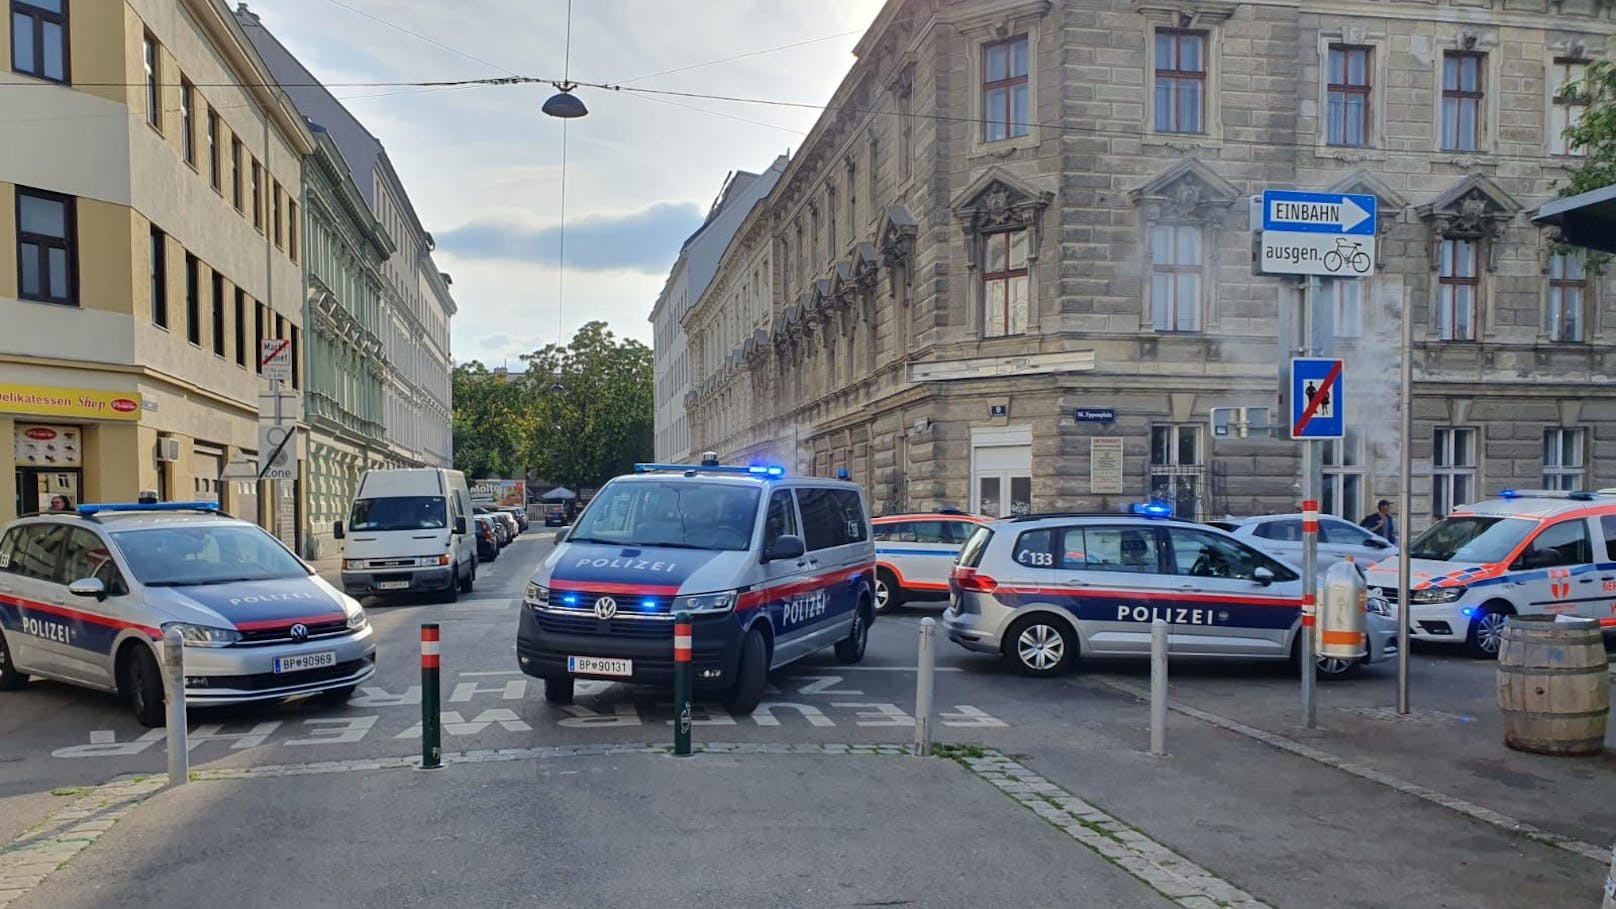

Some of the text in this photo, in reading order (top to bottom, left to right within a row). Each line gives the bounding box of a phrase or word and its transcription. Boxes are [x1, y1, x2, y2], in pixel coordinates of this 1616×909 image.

[1276, 203, 1339, 222] EINBAHN
[1265, 242, 1322, 262] ausgen.
[78, 397, 105, 410] Shop
[264, 467, 291, 478] Zone
[576, 558, 676, 572] POLIZEI
[1029, 553, 1052, 566] 133
[229, 592, 313, 606] POLIZEI
[782, 596, 827, 627] POLIZEI
[1117, 605, 1214, 625] POLIZEI
[22, 616, 70, 644] POLIZEI
[283, 654, 332, 669] BP 90969
[579, 659, 627, 672] BP 90131
